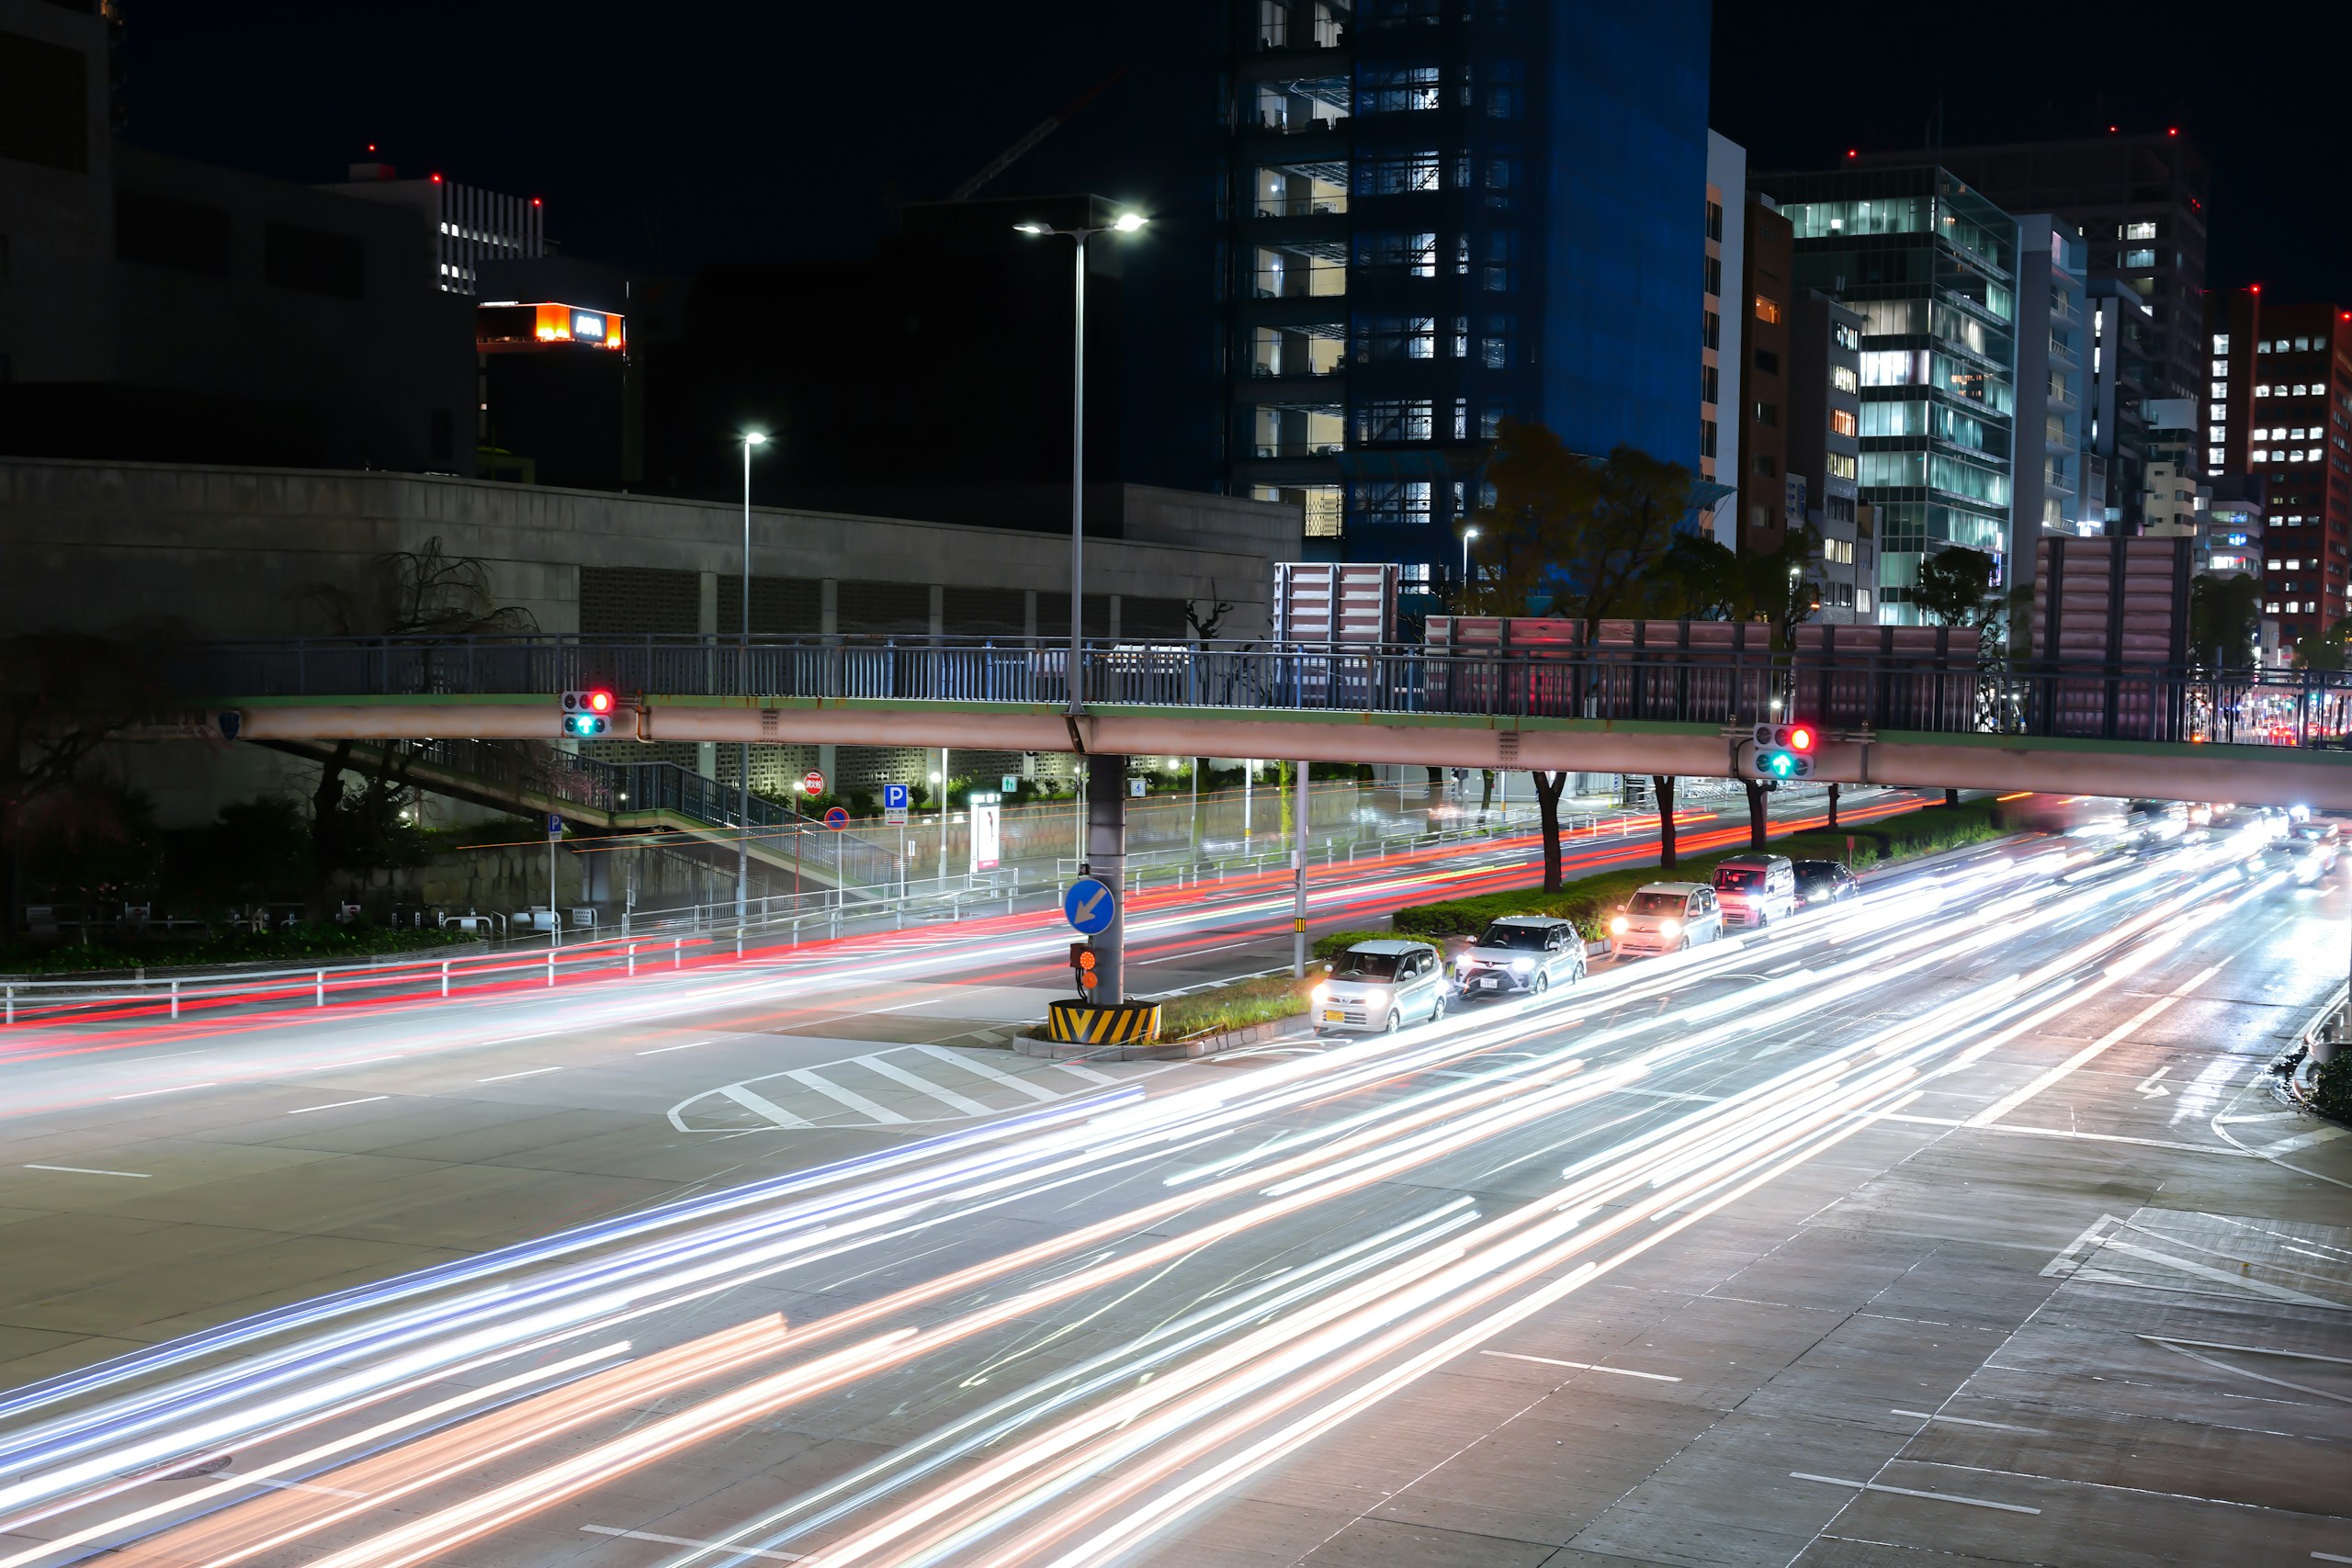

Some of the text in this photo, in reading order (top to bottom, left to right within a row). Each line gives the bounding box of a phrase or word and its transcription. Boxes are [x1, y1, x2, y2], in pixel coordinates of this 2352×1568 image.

[805, 780, 820, 788] 消火栓
[889, 786, 903, 807] P
[552, 816, 560, 830] P
